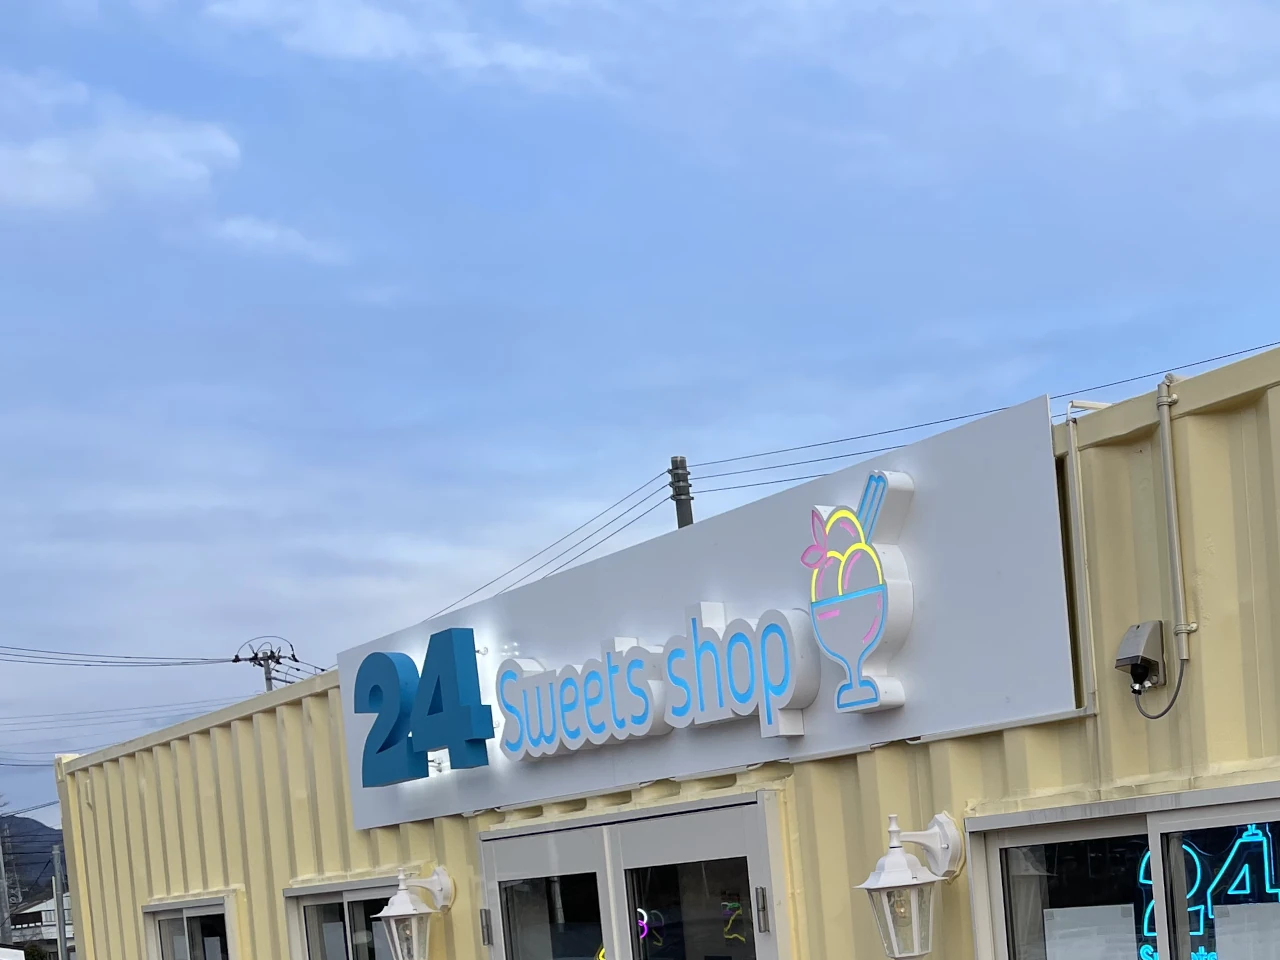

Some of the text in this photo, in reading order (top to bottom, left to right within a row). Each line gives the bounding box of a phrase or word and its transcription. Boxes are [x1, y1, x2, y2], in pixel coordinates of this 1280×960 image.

[353, 615, 793, 788] 24 Sweets shop
